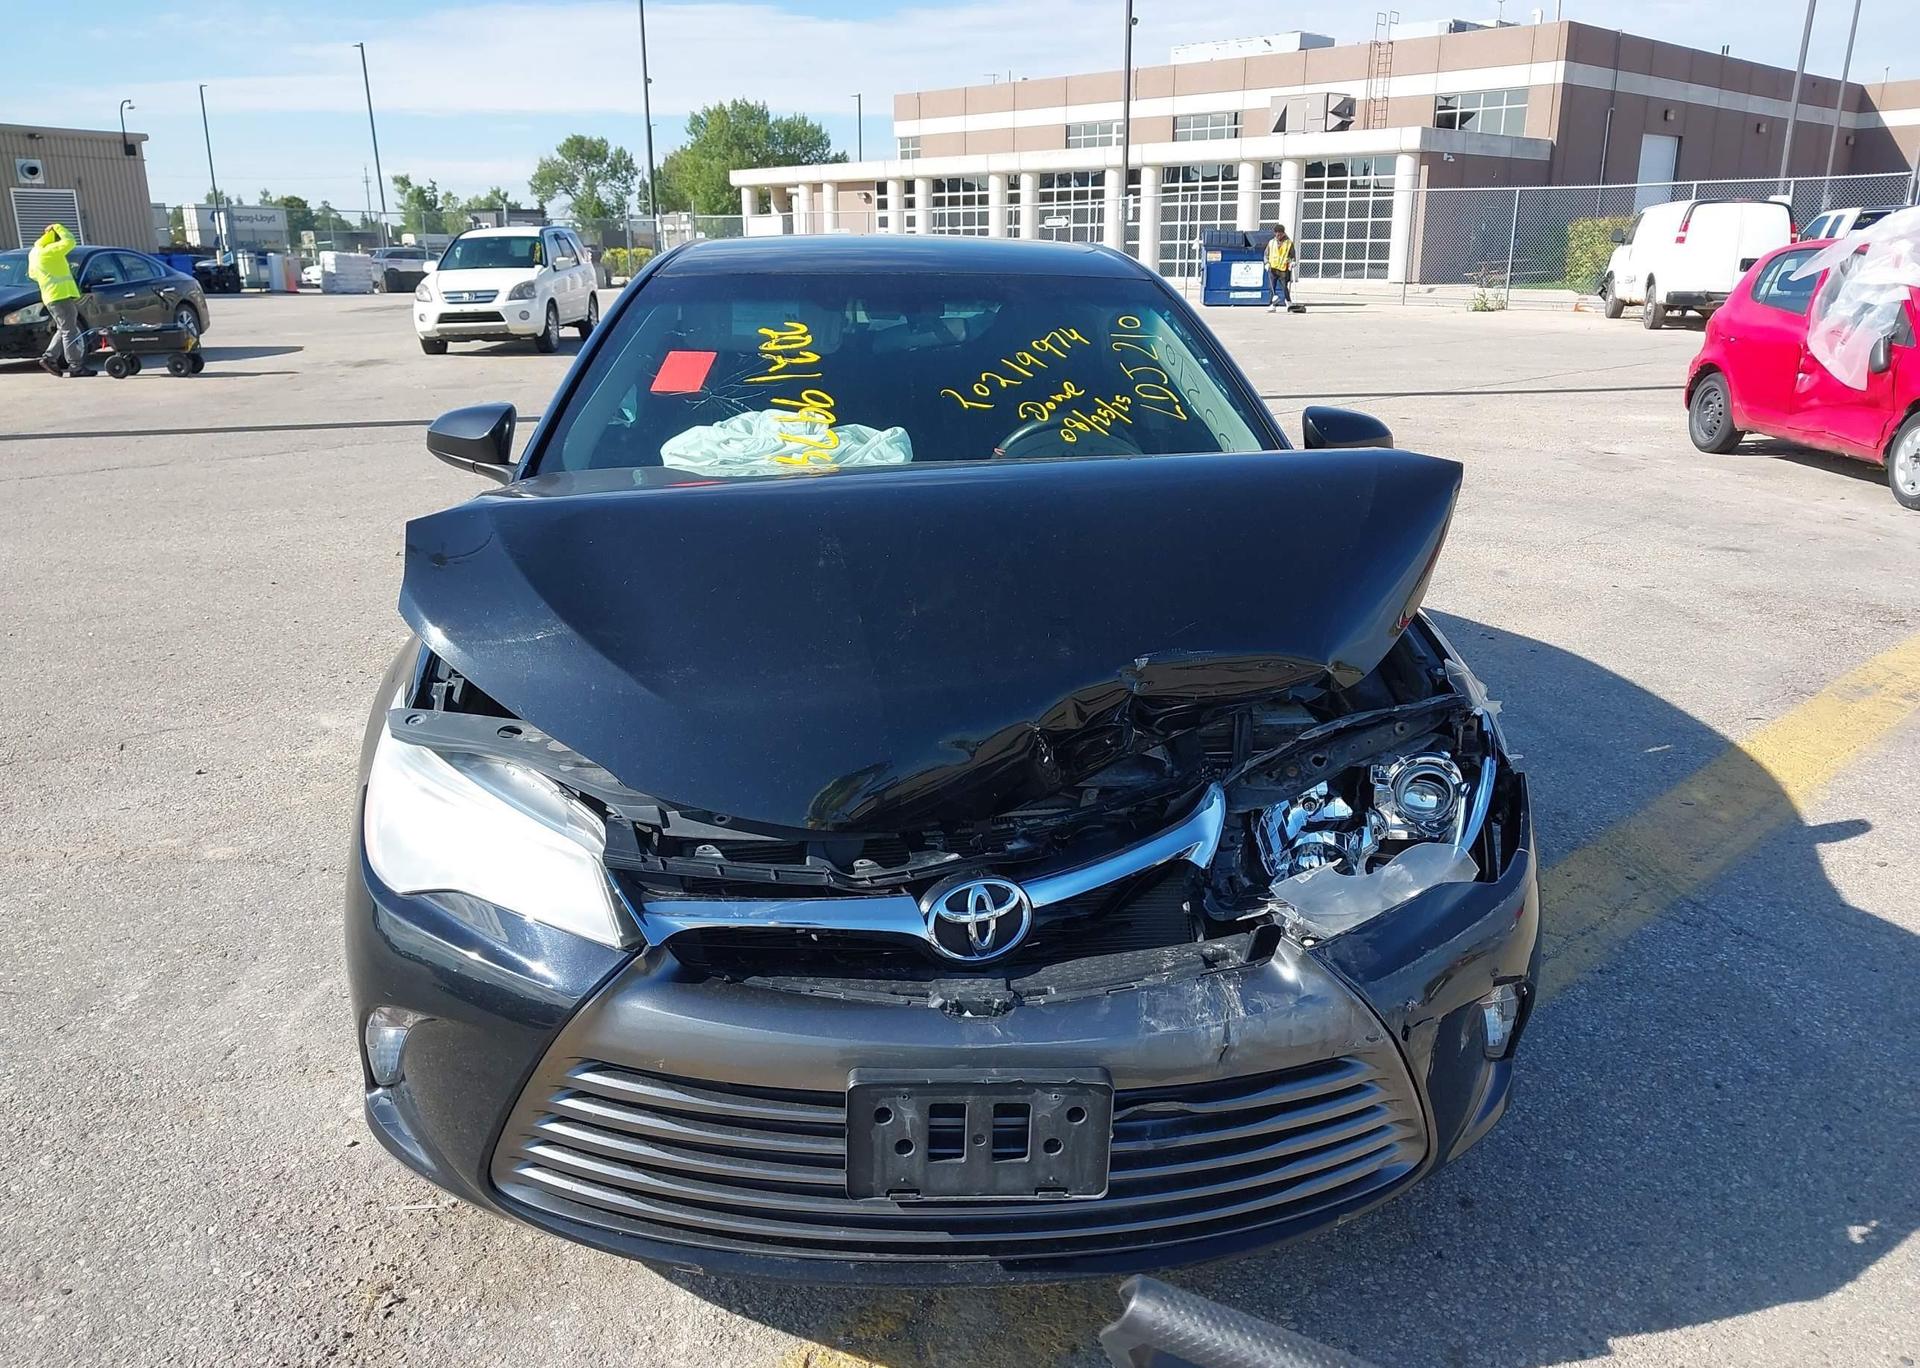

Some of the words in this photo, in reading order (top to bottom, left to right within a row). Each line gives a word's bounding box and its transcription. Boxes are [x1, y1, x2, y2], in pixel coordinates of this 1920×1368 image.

[1110, 315, 1163, 360] 210
[941, 327, 1090, 409] 20219974
[1018, 381, 1086, 421] Done
[1060, 395, 1132, 443] 08/25/25
